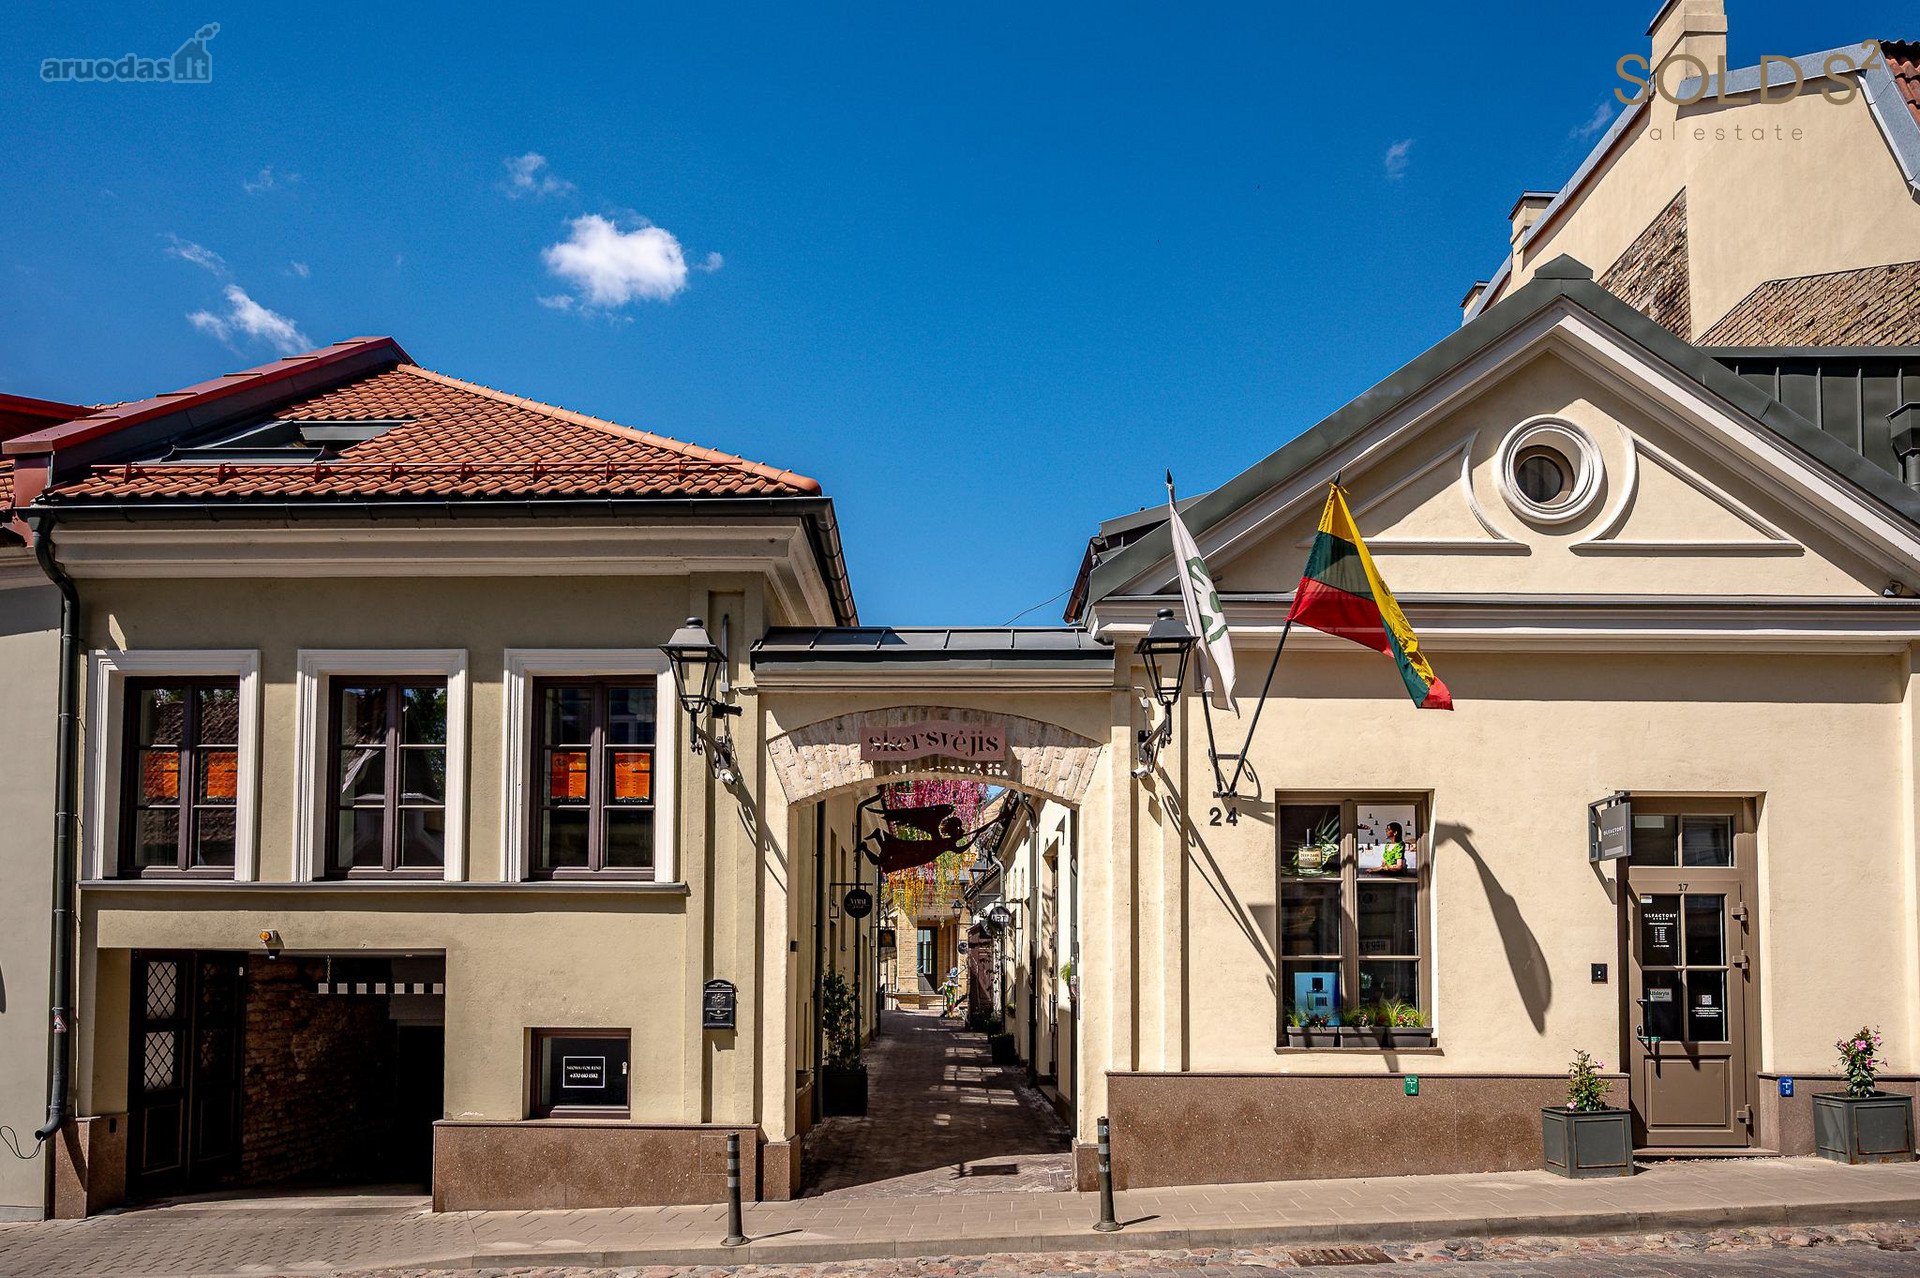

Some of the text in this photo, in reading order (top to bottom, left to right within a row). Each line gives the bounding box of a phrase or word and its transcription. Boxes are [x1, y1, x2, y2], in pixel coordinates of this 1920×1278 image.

[868, 730, 999, 757] skersvėjis
[1209, 806, 1238, 826] 24
[1678, 883, 1688, 891] 17
